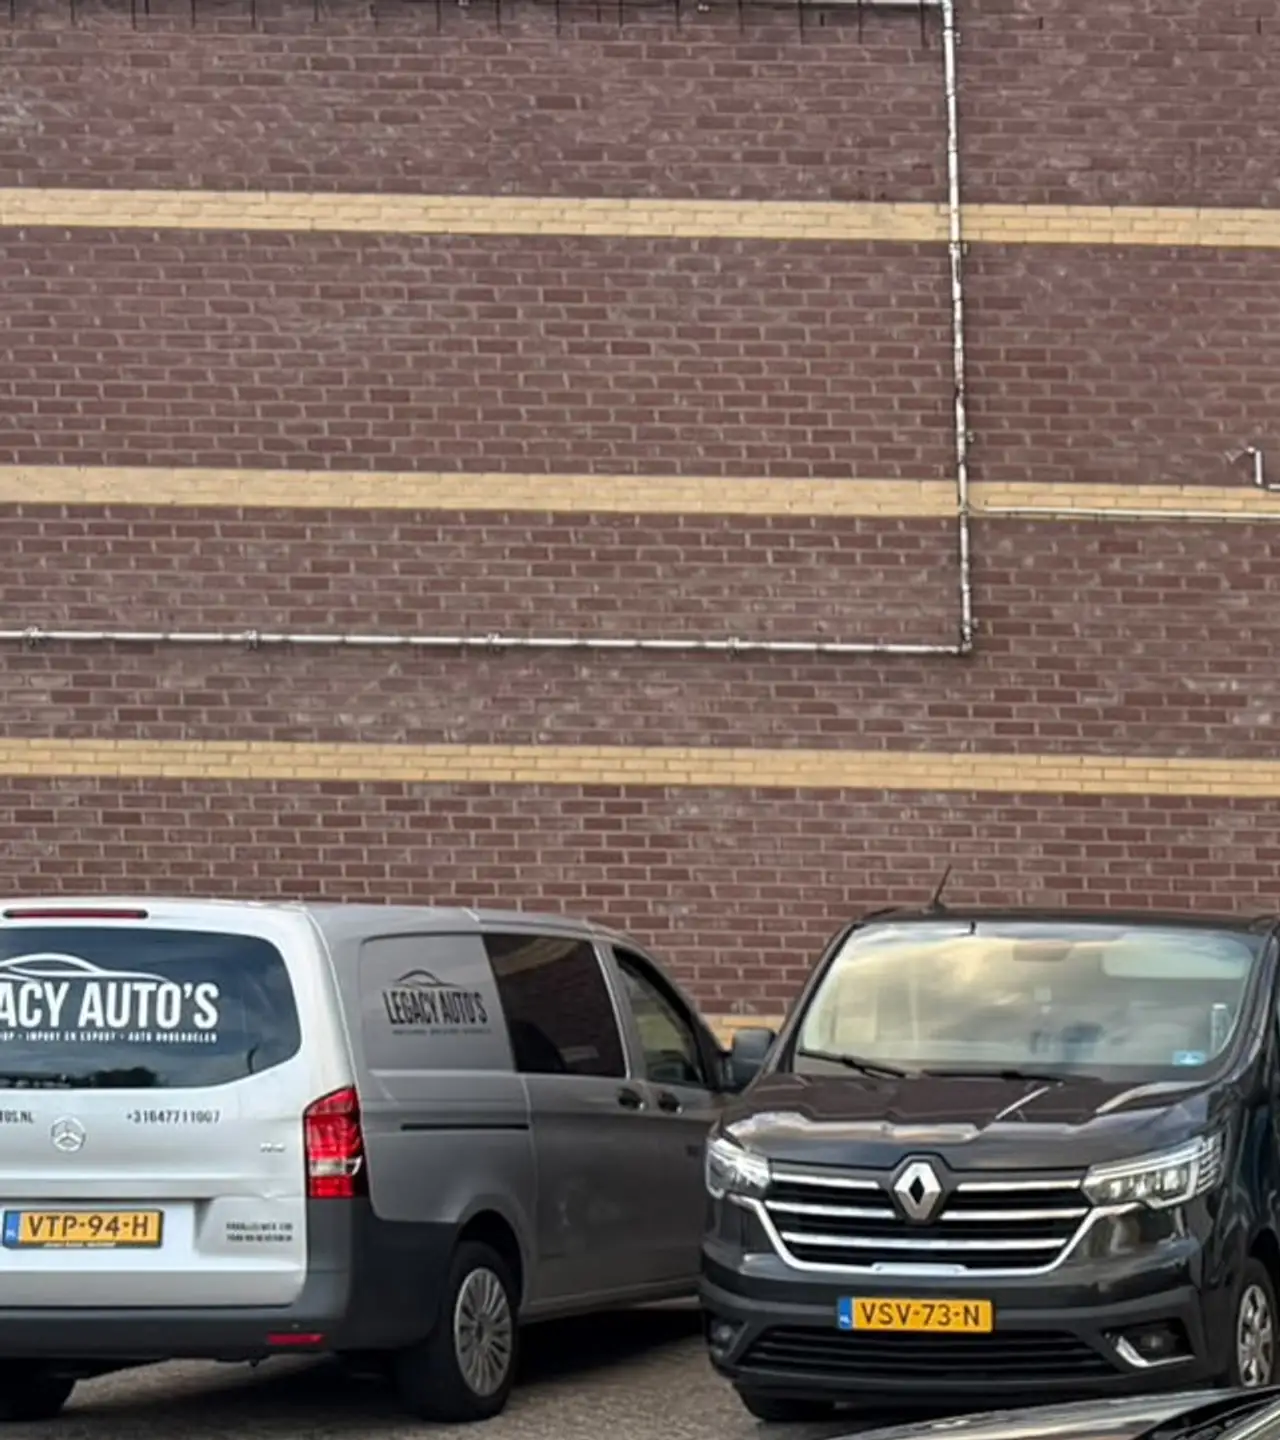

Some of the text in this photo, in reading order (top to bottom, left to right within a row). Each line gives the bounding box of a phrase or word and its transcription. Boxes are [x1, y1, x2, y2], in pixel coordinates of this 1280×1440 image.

[78, 981, 220, 1030] AUTO'S
[382, 990, 438, 1025] LEGACY
[28, 1215, 149, 1238] VTP-94-H
[859, 1302, 980, 1327] VSV-73-N
